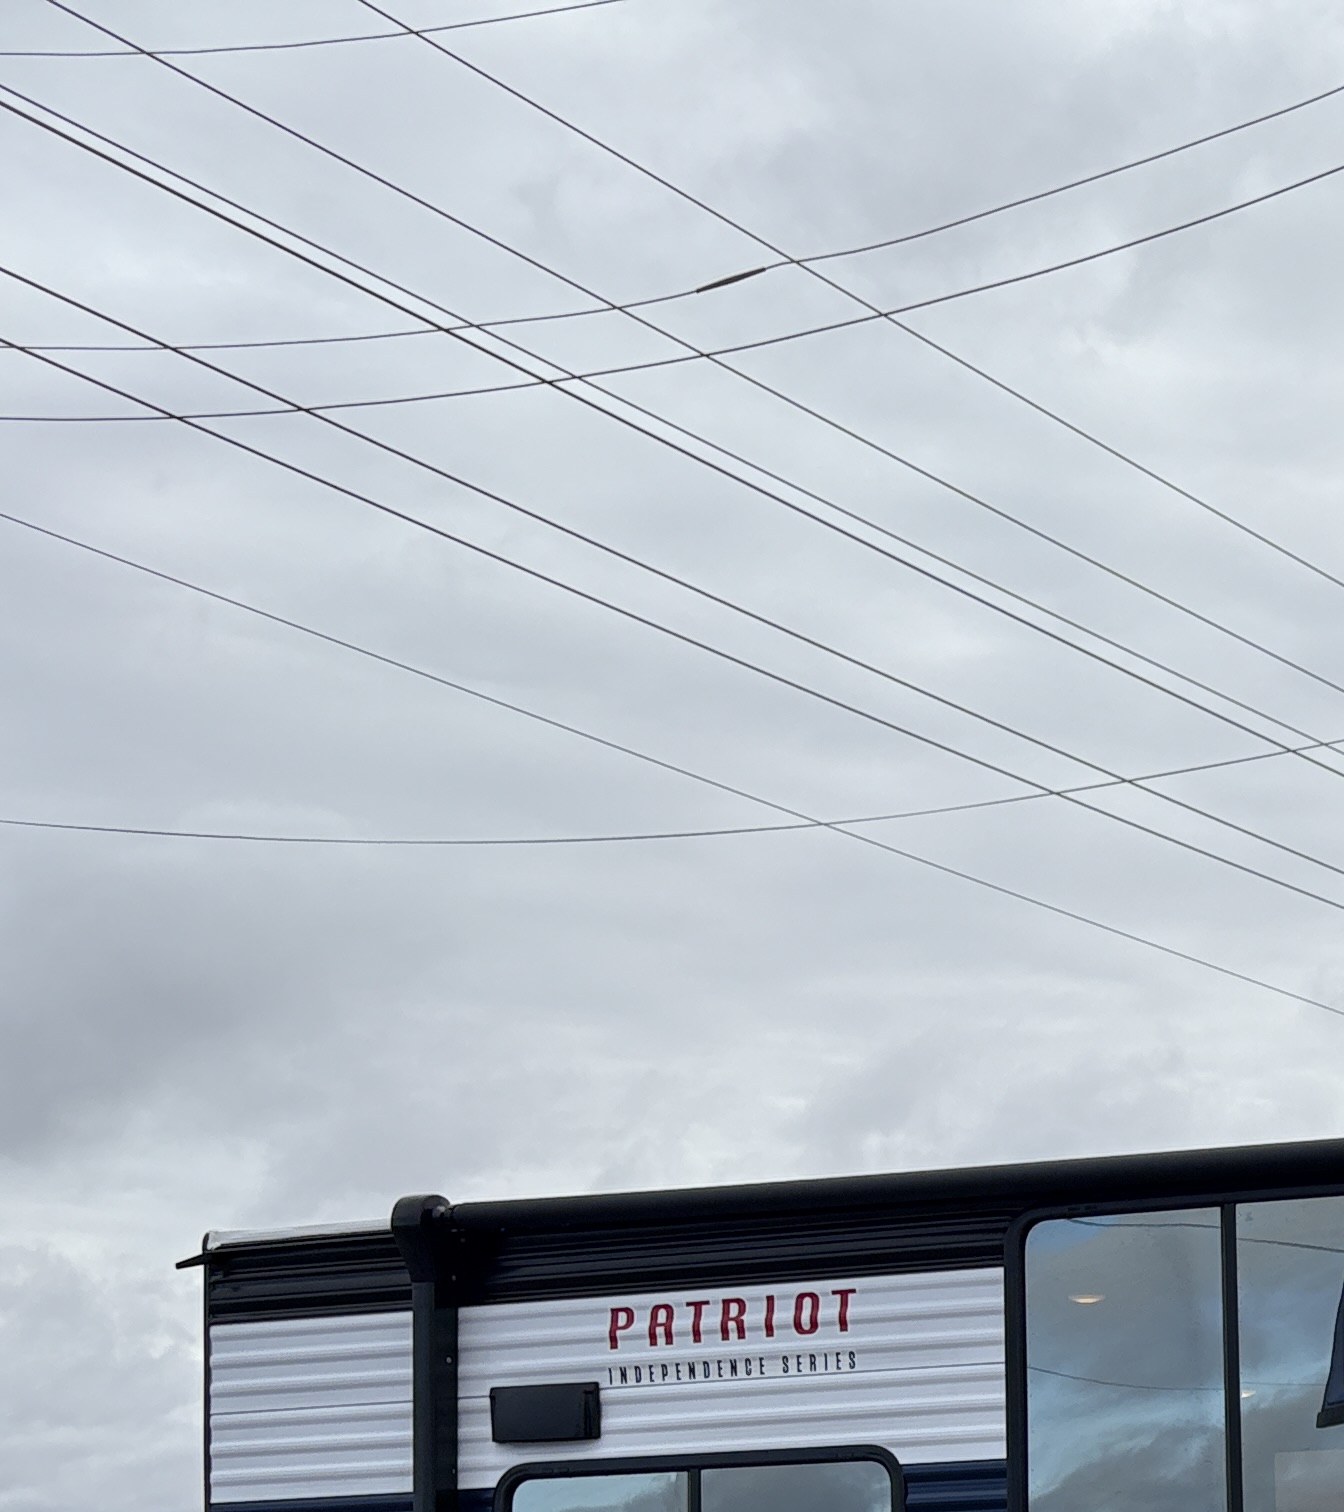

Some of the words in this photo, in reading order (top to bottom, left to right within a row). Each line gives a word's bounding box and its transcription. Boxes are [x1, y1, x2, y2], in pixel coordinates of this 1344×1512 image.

[609, 1289, 857, 1350] PATRIOT
[608, 1357, 766, 1385] INDEPENDENCE
[782, 1351, 857, 1374] SERIES
